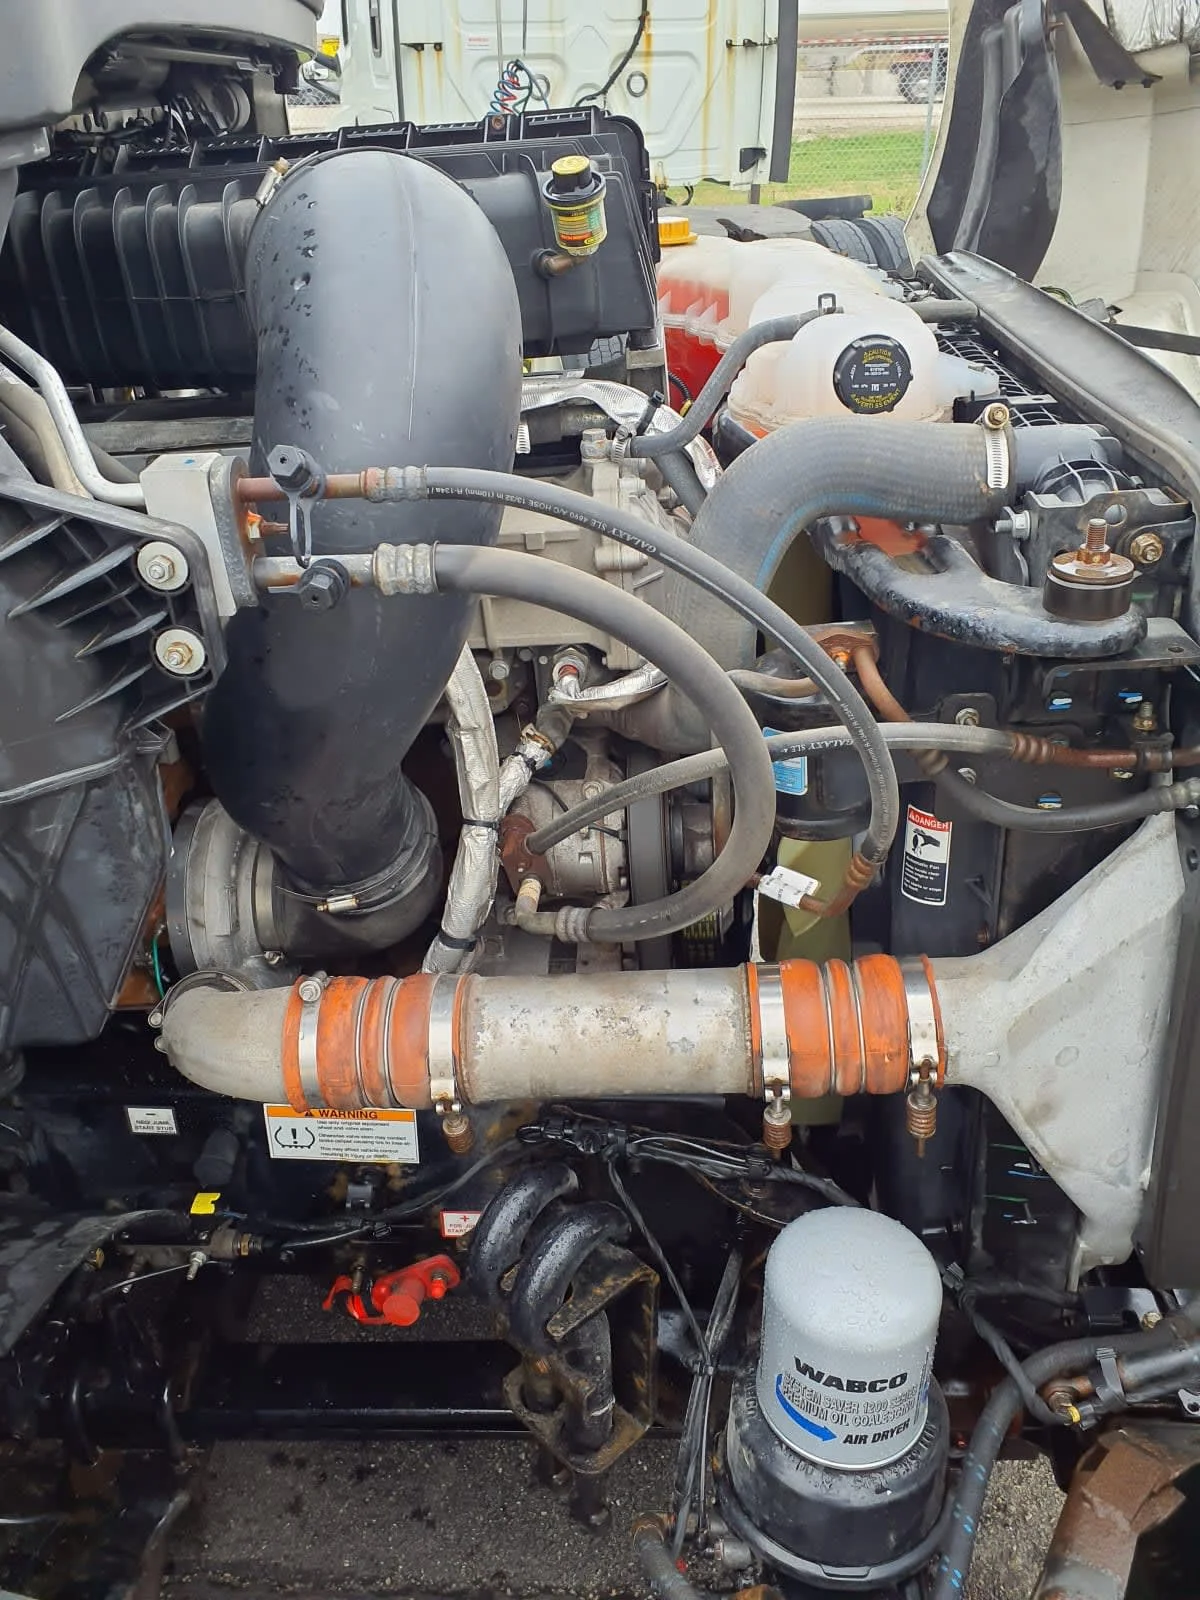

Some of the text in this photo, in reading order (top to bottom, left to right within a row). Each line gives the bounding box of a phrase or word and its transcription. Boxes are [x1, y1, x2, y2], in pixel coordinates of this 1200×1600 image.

[528, 498, 552, 512] HOSE
[590, 518, 608, 532] SLE
[608, 527, 657, 553] GALAXY
[790, 744, 806, 752] SLE
[807, 738, 854, 751] GALAXY
[915, 815, 949, 830] DANGER
[319, 1110, 378, 1119] WARNING
[794, 1355, 908, 1394] WABCO
[783, 1372, 822, 1405] SYSTEM
[823, 1396, 860, 1415] SAVER
[862, 1400, 889, 1414] 1200
[782, 1384, 829, 1422] PREMIUM
[830, 1411, 850, 1427] OIL
[842, 1418, 911, 1445] AIR DRYER
